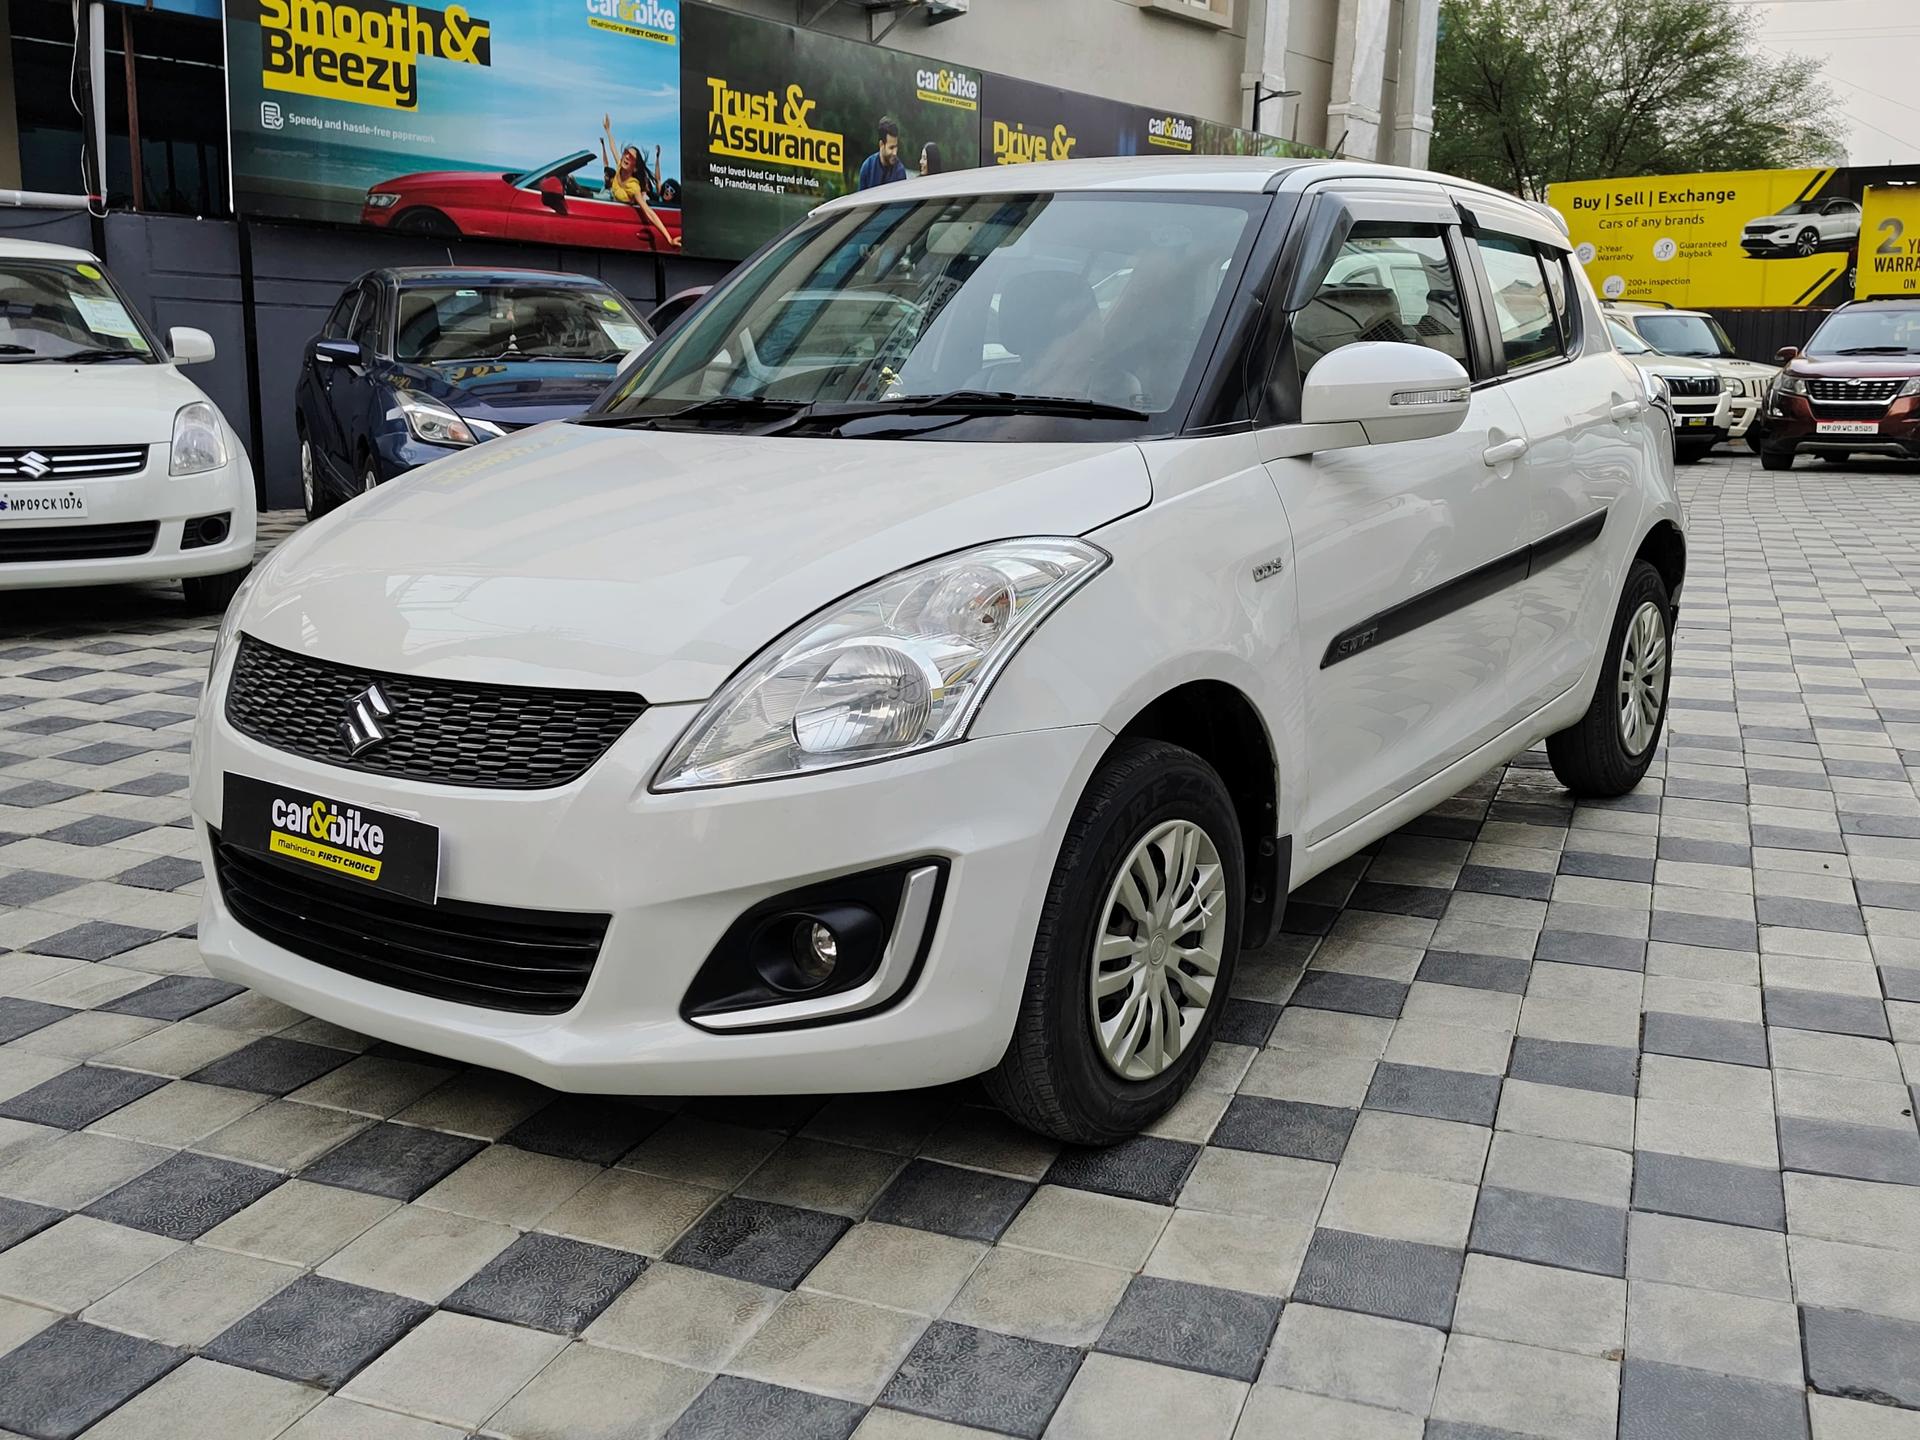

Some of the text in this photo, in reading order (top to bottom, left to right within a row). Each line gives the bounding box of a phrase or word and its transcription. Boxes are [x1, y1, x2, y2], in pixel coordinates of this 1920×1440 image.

[260, 0, 490, 64] Smooth &
[625, 26, 645, 37] FIRST
[645, 31, 669, 42] CHOICE
[261, 27, 418, 108] Breezy
[916, 69, 978, 100] car&bike
[707, 77, 816, 129] Trust &
[288, 112, 436, 145] Speedy and hassle-free paperwork
[709, 114, 841, 166] Assurance
[1148, 117, 1193, 142] car&bike
[993, 121, 1077, 160] Drive &
[709, 163, 820, 188] Most loved Used Car brand of India
[714, 176, 724, 188] By
[725, 178, 757, 192] Franchise
[757, 182, 776, 194] India,
[776, 185, 786, 194] ET
[1573, 197, 1602, 211] Buy
[1614, 191, 1644, 207] Sell
[1658, 189, 1736, 205] Exchange
[1599, 214, 1705, 230] Cars of any brands
[1679, 240, 1728, 250] Guaranteed
[1876, 217, 1904, 255] 2
[1598, 245, 1623, 254] 2-Year
[1598, 253, 1634, 262] Warranty
[1679, 249, 1713, 259] Buyback
[1874, 257, 1920, 273] WARRA
[1626, 286, 1652, 296] points
[1627, 277, 1691, 288] 200+ inspection
[1903, 278, 1916, 290] ON
[272, 798, 384, 855] car&bike
[278, 838, 376, 874] Mahindra FIRST CHOICE
